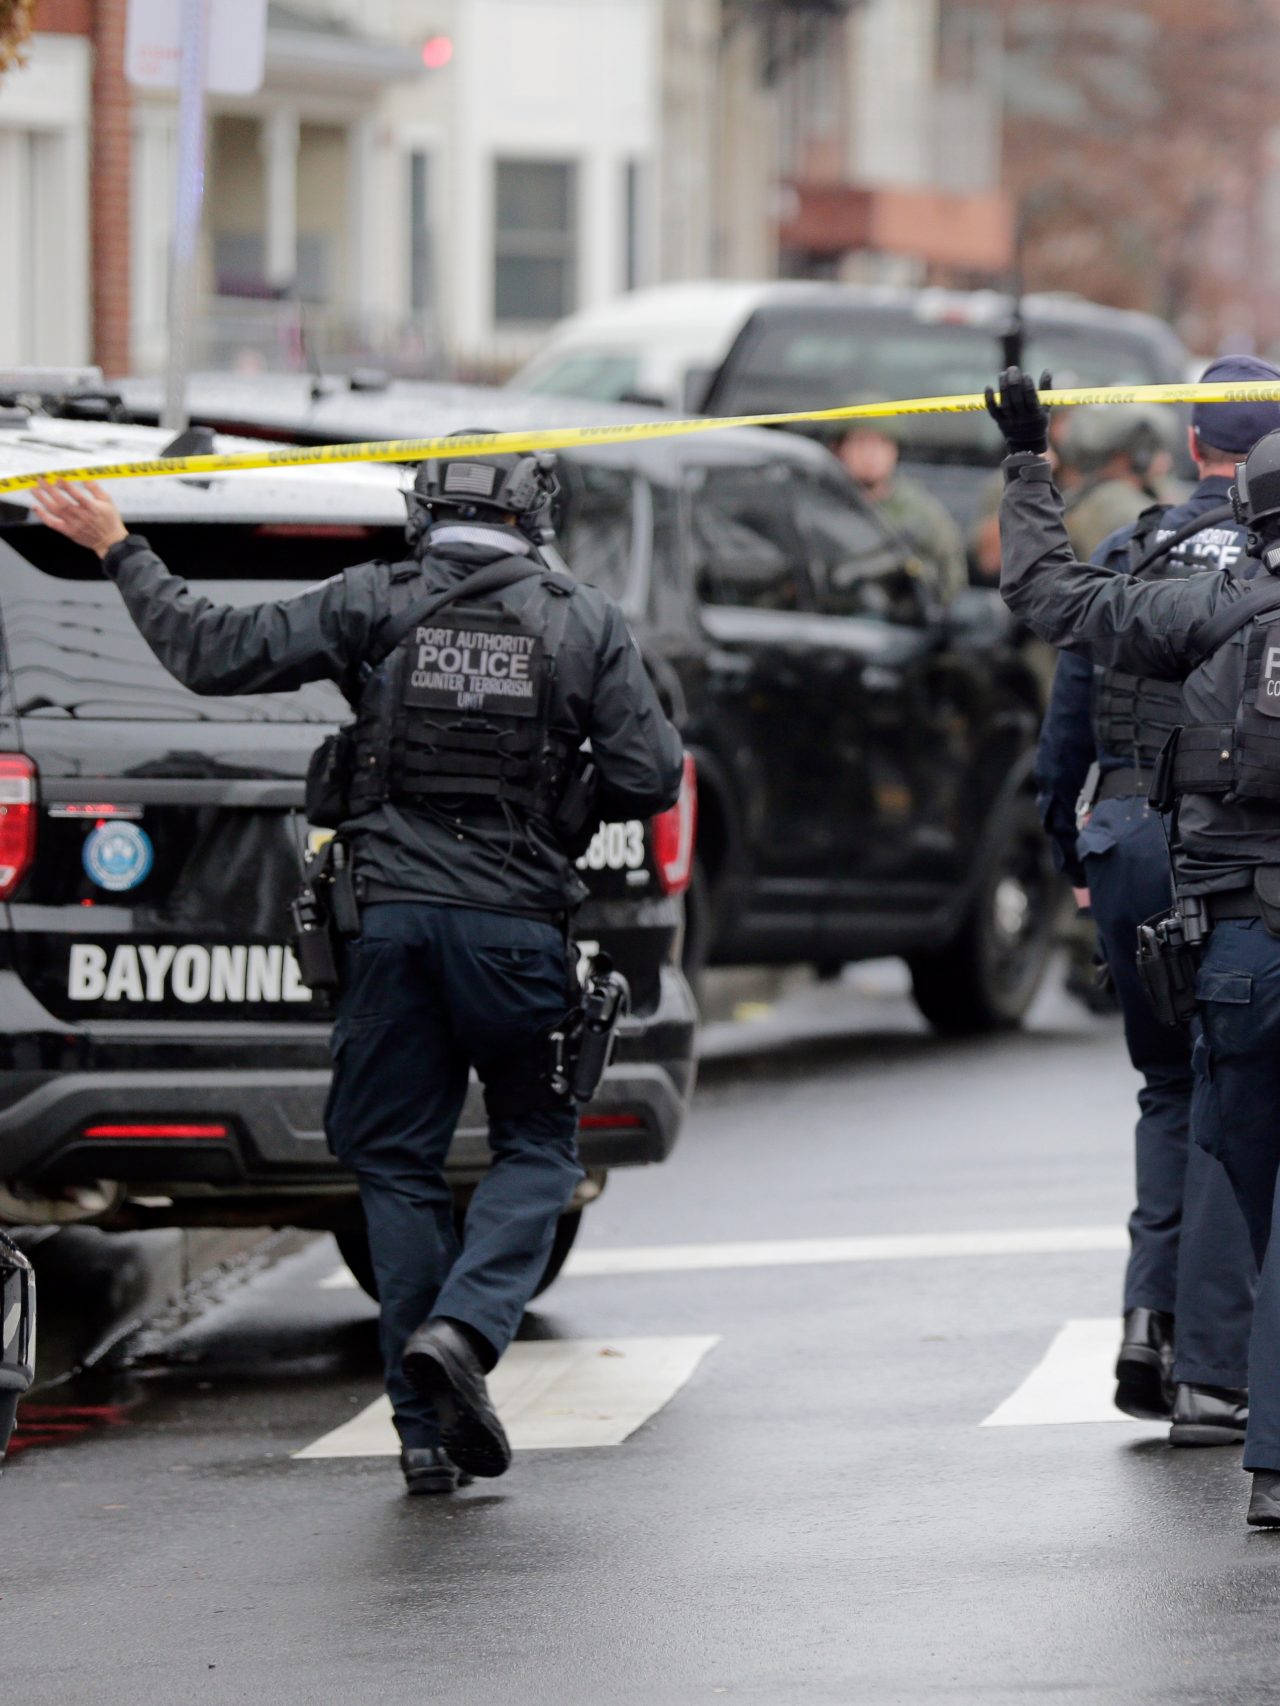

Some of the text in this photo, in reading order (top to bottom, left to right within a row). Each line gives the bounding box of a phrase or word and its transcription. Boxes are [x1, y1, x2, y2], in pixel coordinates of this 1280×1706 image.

[416, 626, 535, 654] PORT AUTHORITY
[417, 645, 530, 679] POLICE
[411, 670, 533, 697] COUNTER TERRORISM
[575, 820, 645, 870] 803
